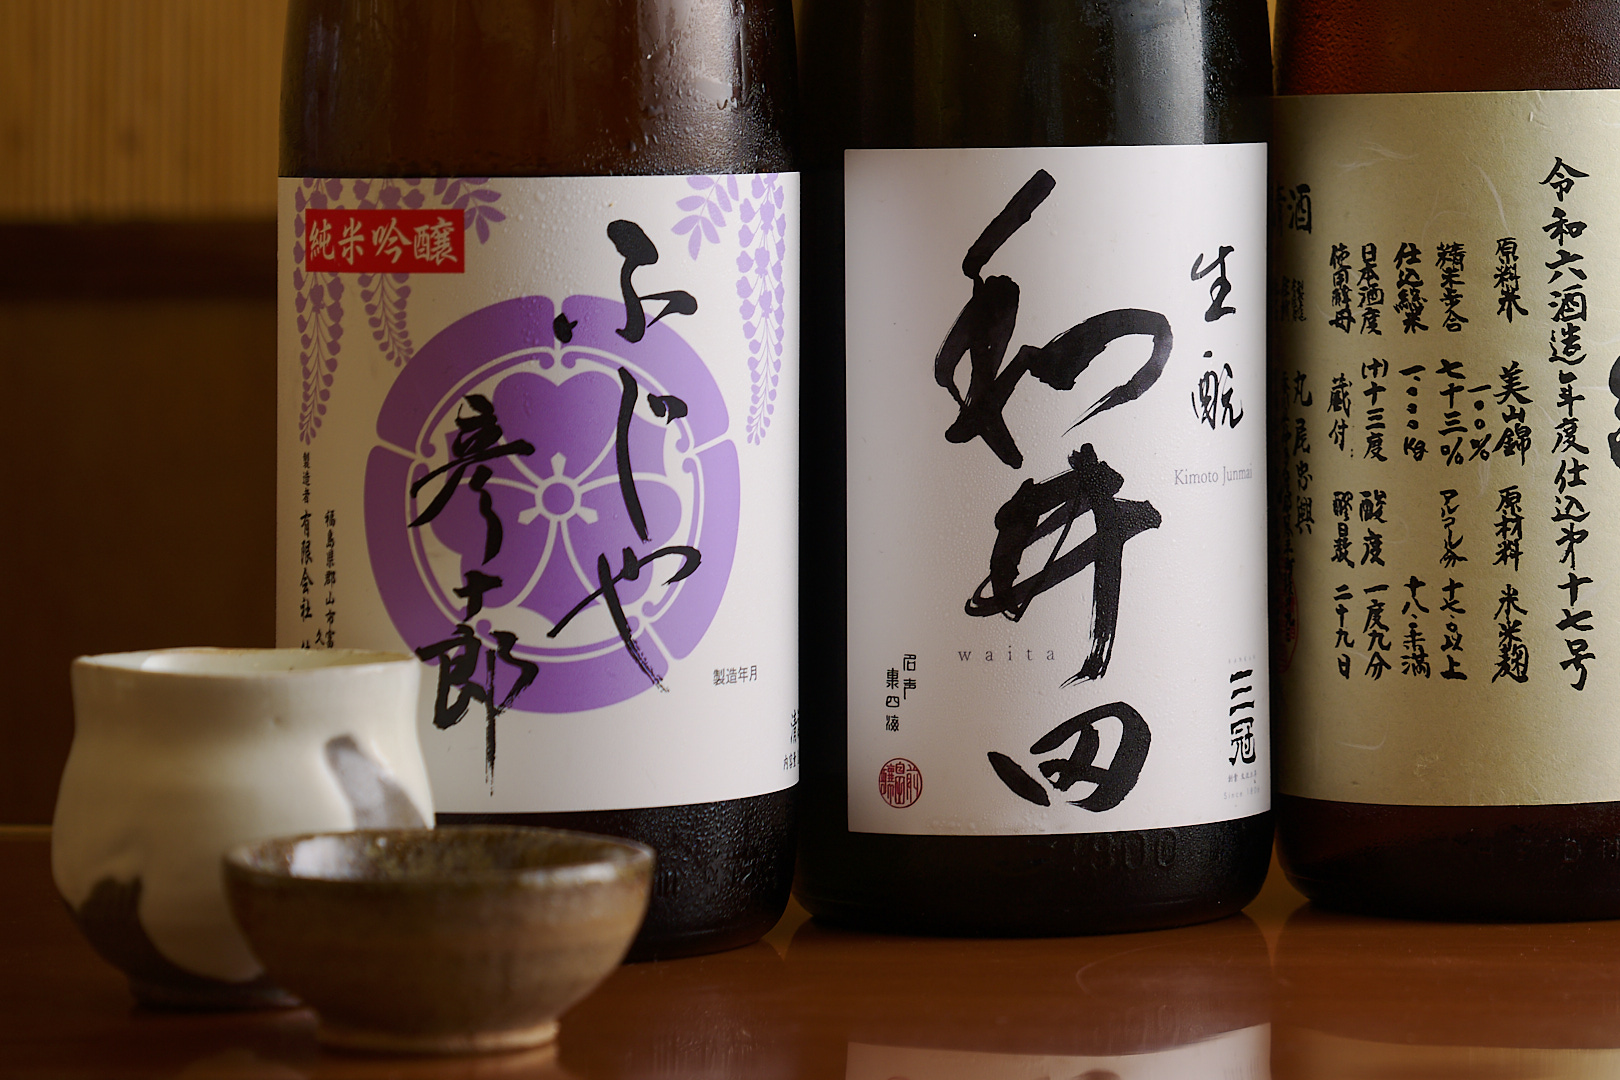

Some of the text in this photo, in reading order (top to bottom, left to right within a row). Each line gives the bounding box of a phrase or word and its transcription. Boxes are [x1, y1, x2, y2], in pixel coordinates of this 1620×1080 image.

[308, 216, 459, 266] 純米吟醸
[1493, 236, 1529, 324] 原料米
[1357, 242, 1385, 336] 日本酒度
[1435, 241, 1469, 333] 精米歩合
[547, 219, 702, 694] ふじや
[1326, 372, 1353, 452] 蔵付
[1491, 360, 1534, 467] 美山錦
[934, 168, 1174, 814] 和井田
[1173, 462, 1253, 487] Kimoto Junmai
[1358, 489, 1388, 568] 酸度
[1492, 484, 1525, 572] 原材料
[712, 664, 758, 687] 製造年月
[957, 645, 1056, 662] waita
[1332, 583, 1356, 680] 二十九日
[1362, 583, 1392, 682] 一度九分
[1228, 669, 1257, 766] 三冠
